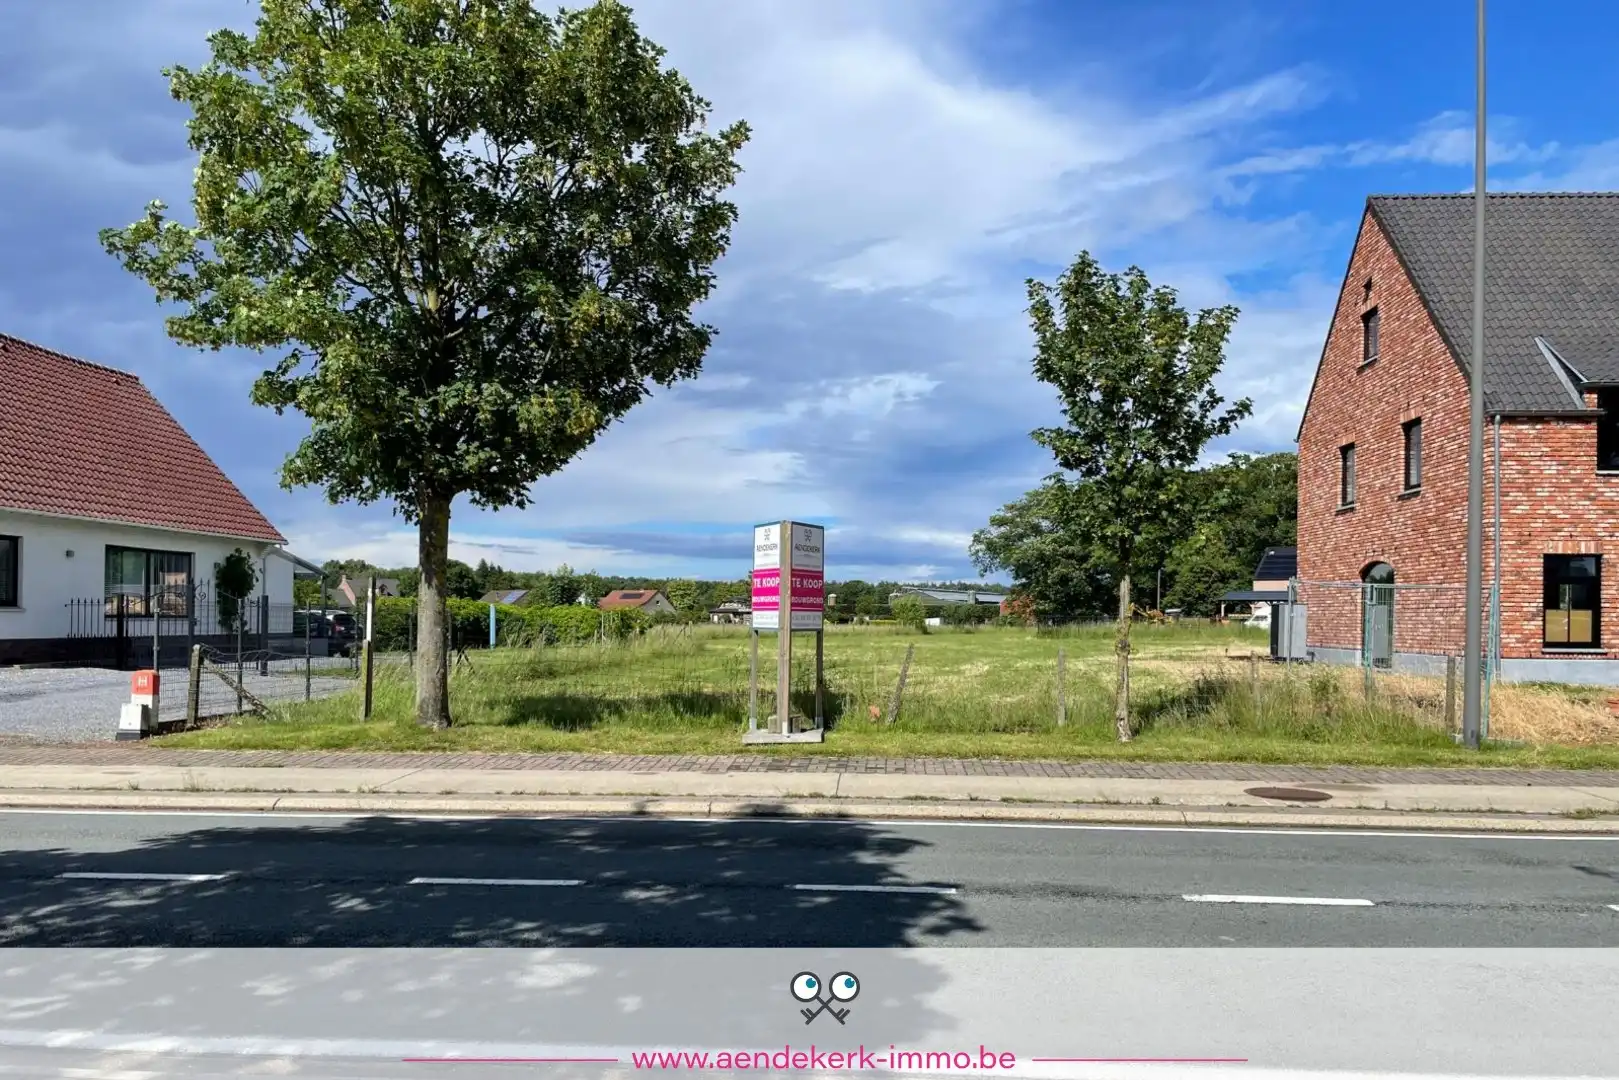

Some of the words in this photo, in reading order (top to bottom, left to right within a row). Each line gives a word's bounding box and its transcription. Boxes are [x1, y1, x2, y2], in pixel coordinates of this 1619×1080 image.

[754, 578, 761, 588] TE
[762, 577, 780, 587] KOOP
[792, 578, 801, 588] TE
[803, 578, 823, 589] KOOP
